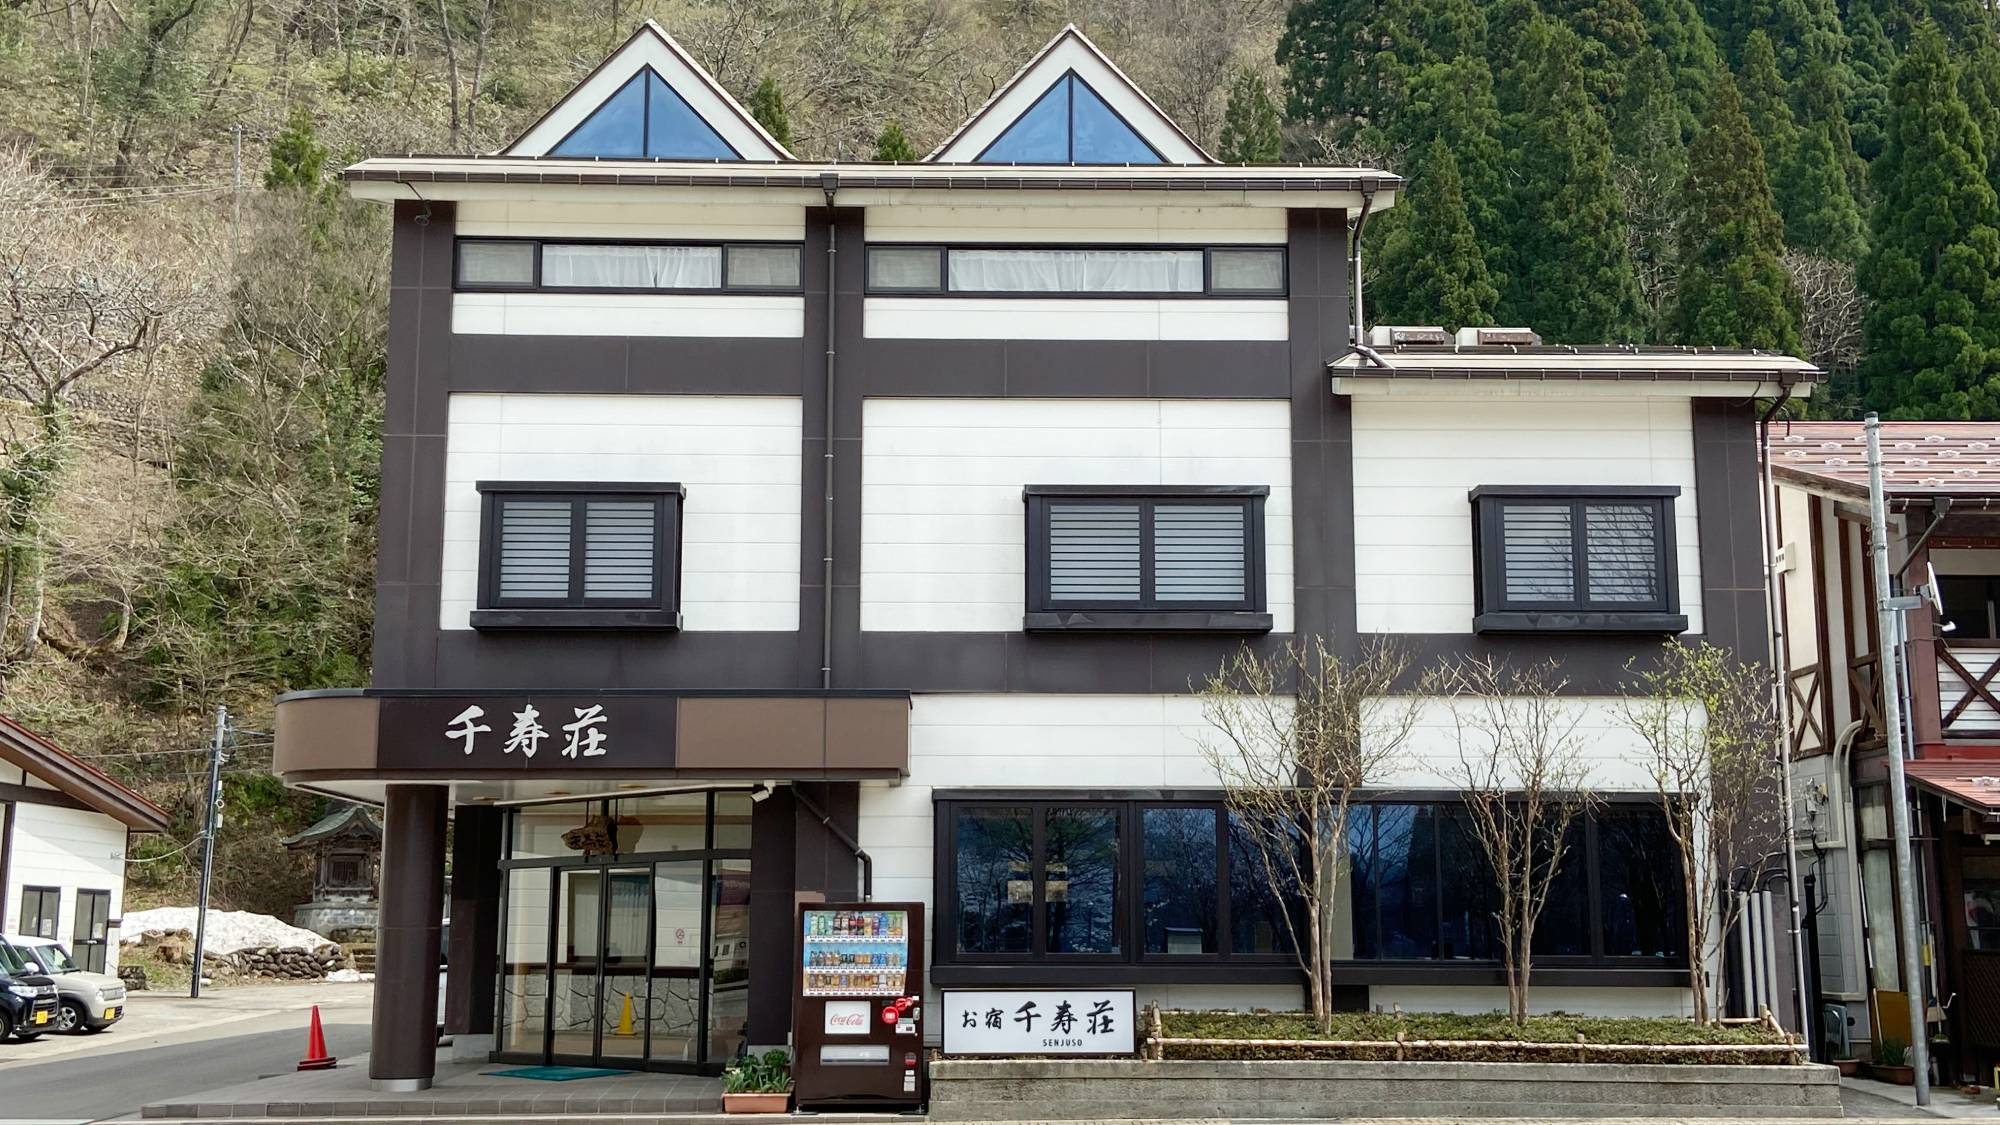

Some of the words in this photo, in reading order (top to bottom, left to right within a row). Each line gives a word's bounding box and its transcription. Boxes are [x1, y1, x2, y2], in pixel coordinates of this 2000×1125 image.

[445, 704, 608, 759] 千寿荘
[1042, 1039, 1083, 1047] SENJUSO
